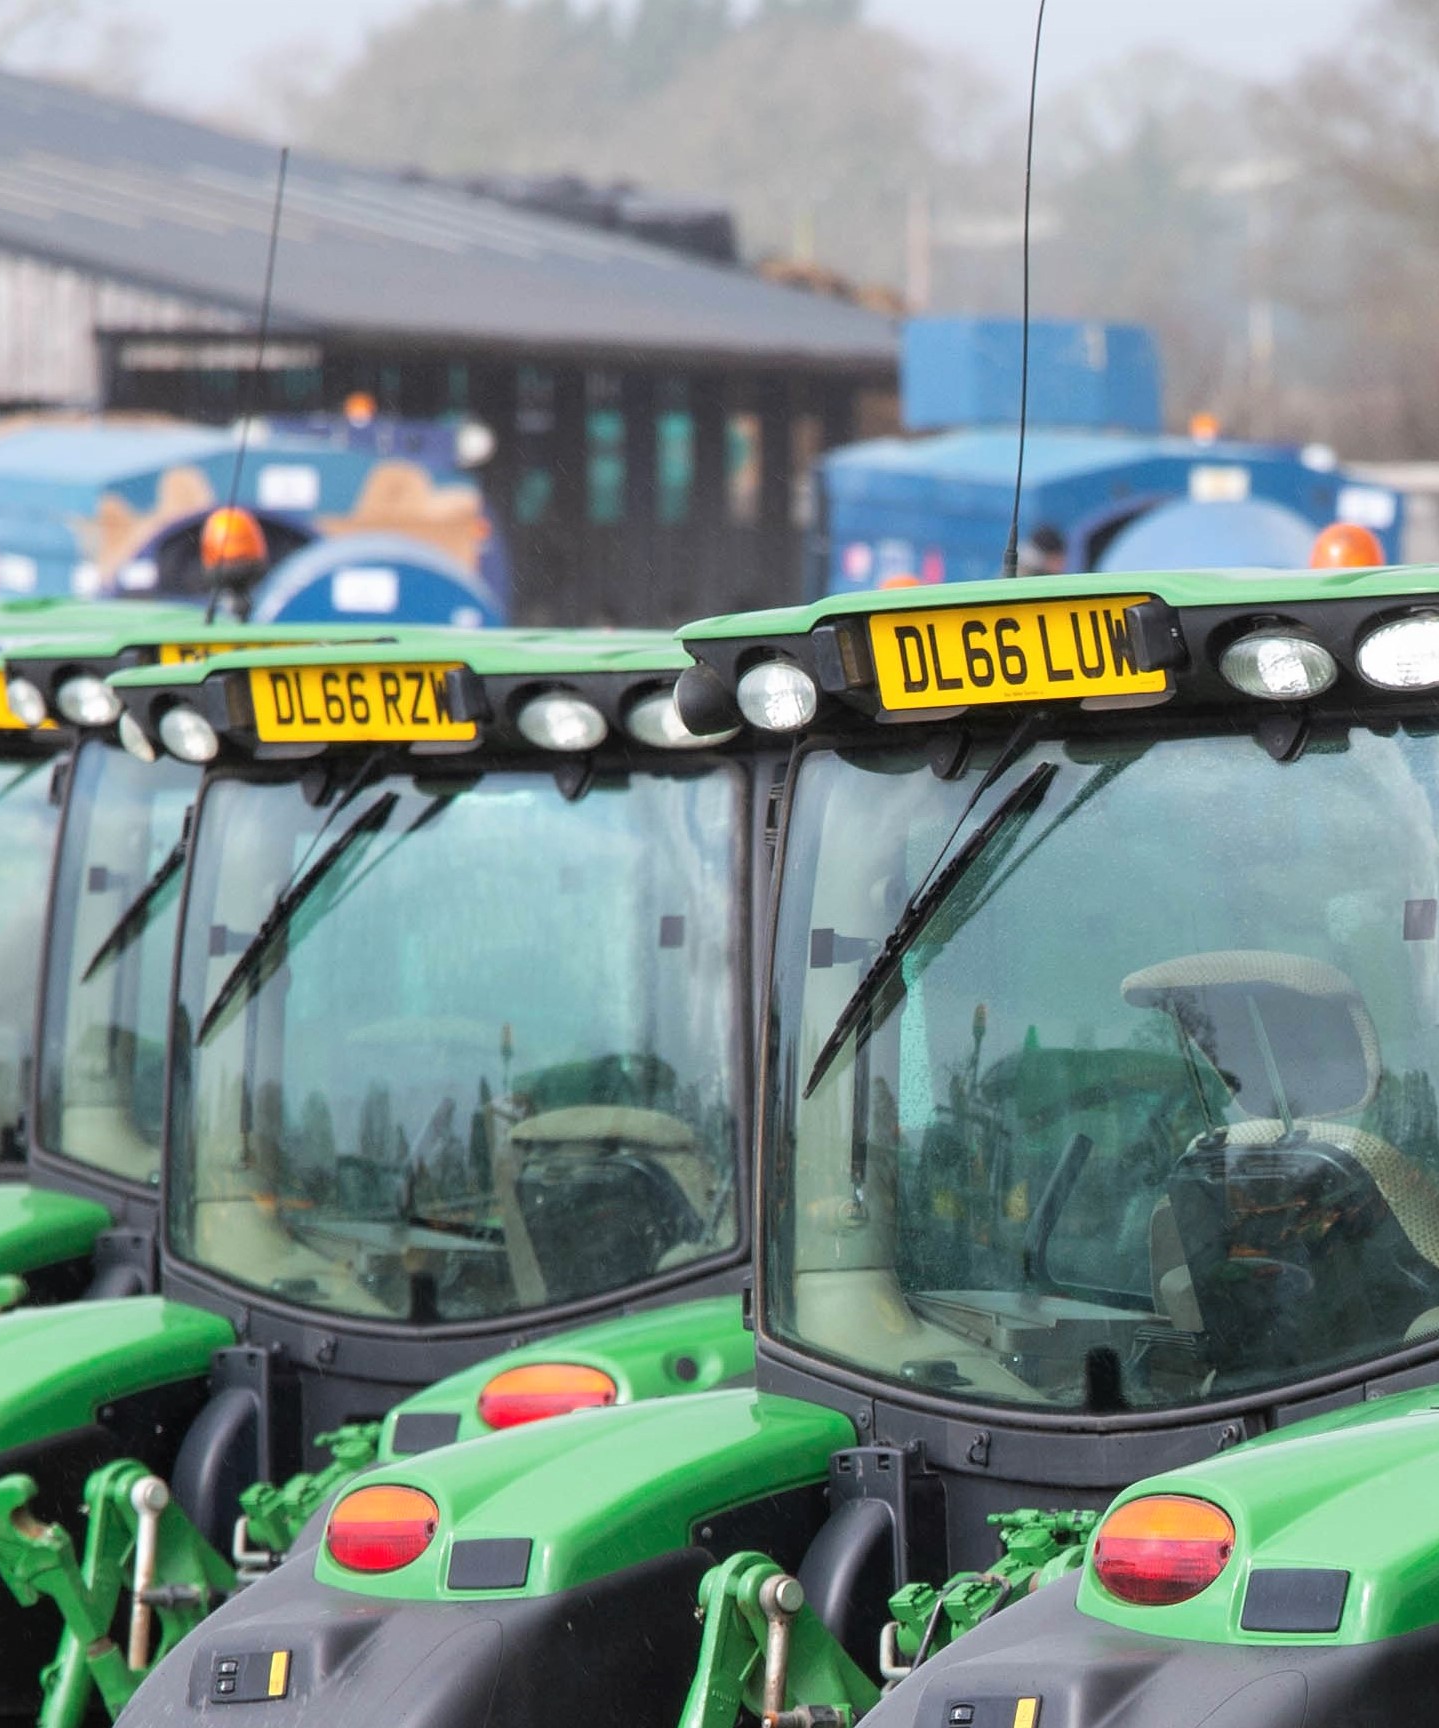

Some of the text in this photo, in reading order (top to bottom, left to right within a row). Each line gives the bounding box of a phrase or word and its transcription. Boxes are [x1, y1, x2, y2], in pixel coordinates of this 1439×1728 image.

[894, 608, 1139, 693] DL66 LUW
[269, 671, 454, 725] DL66 RZW
